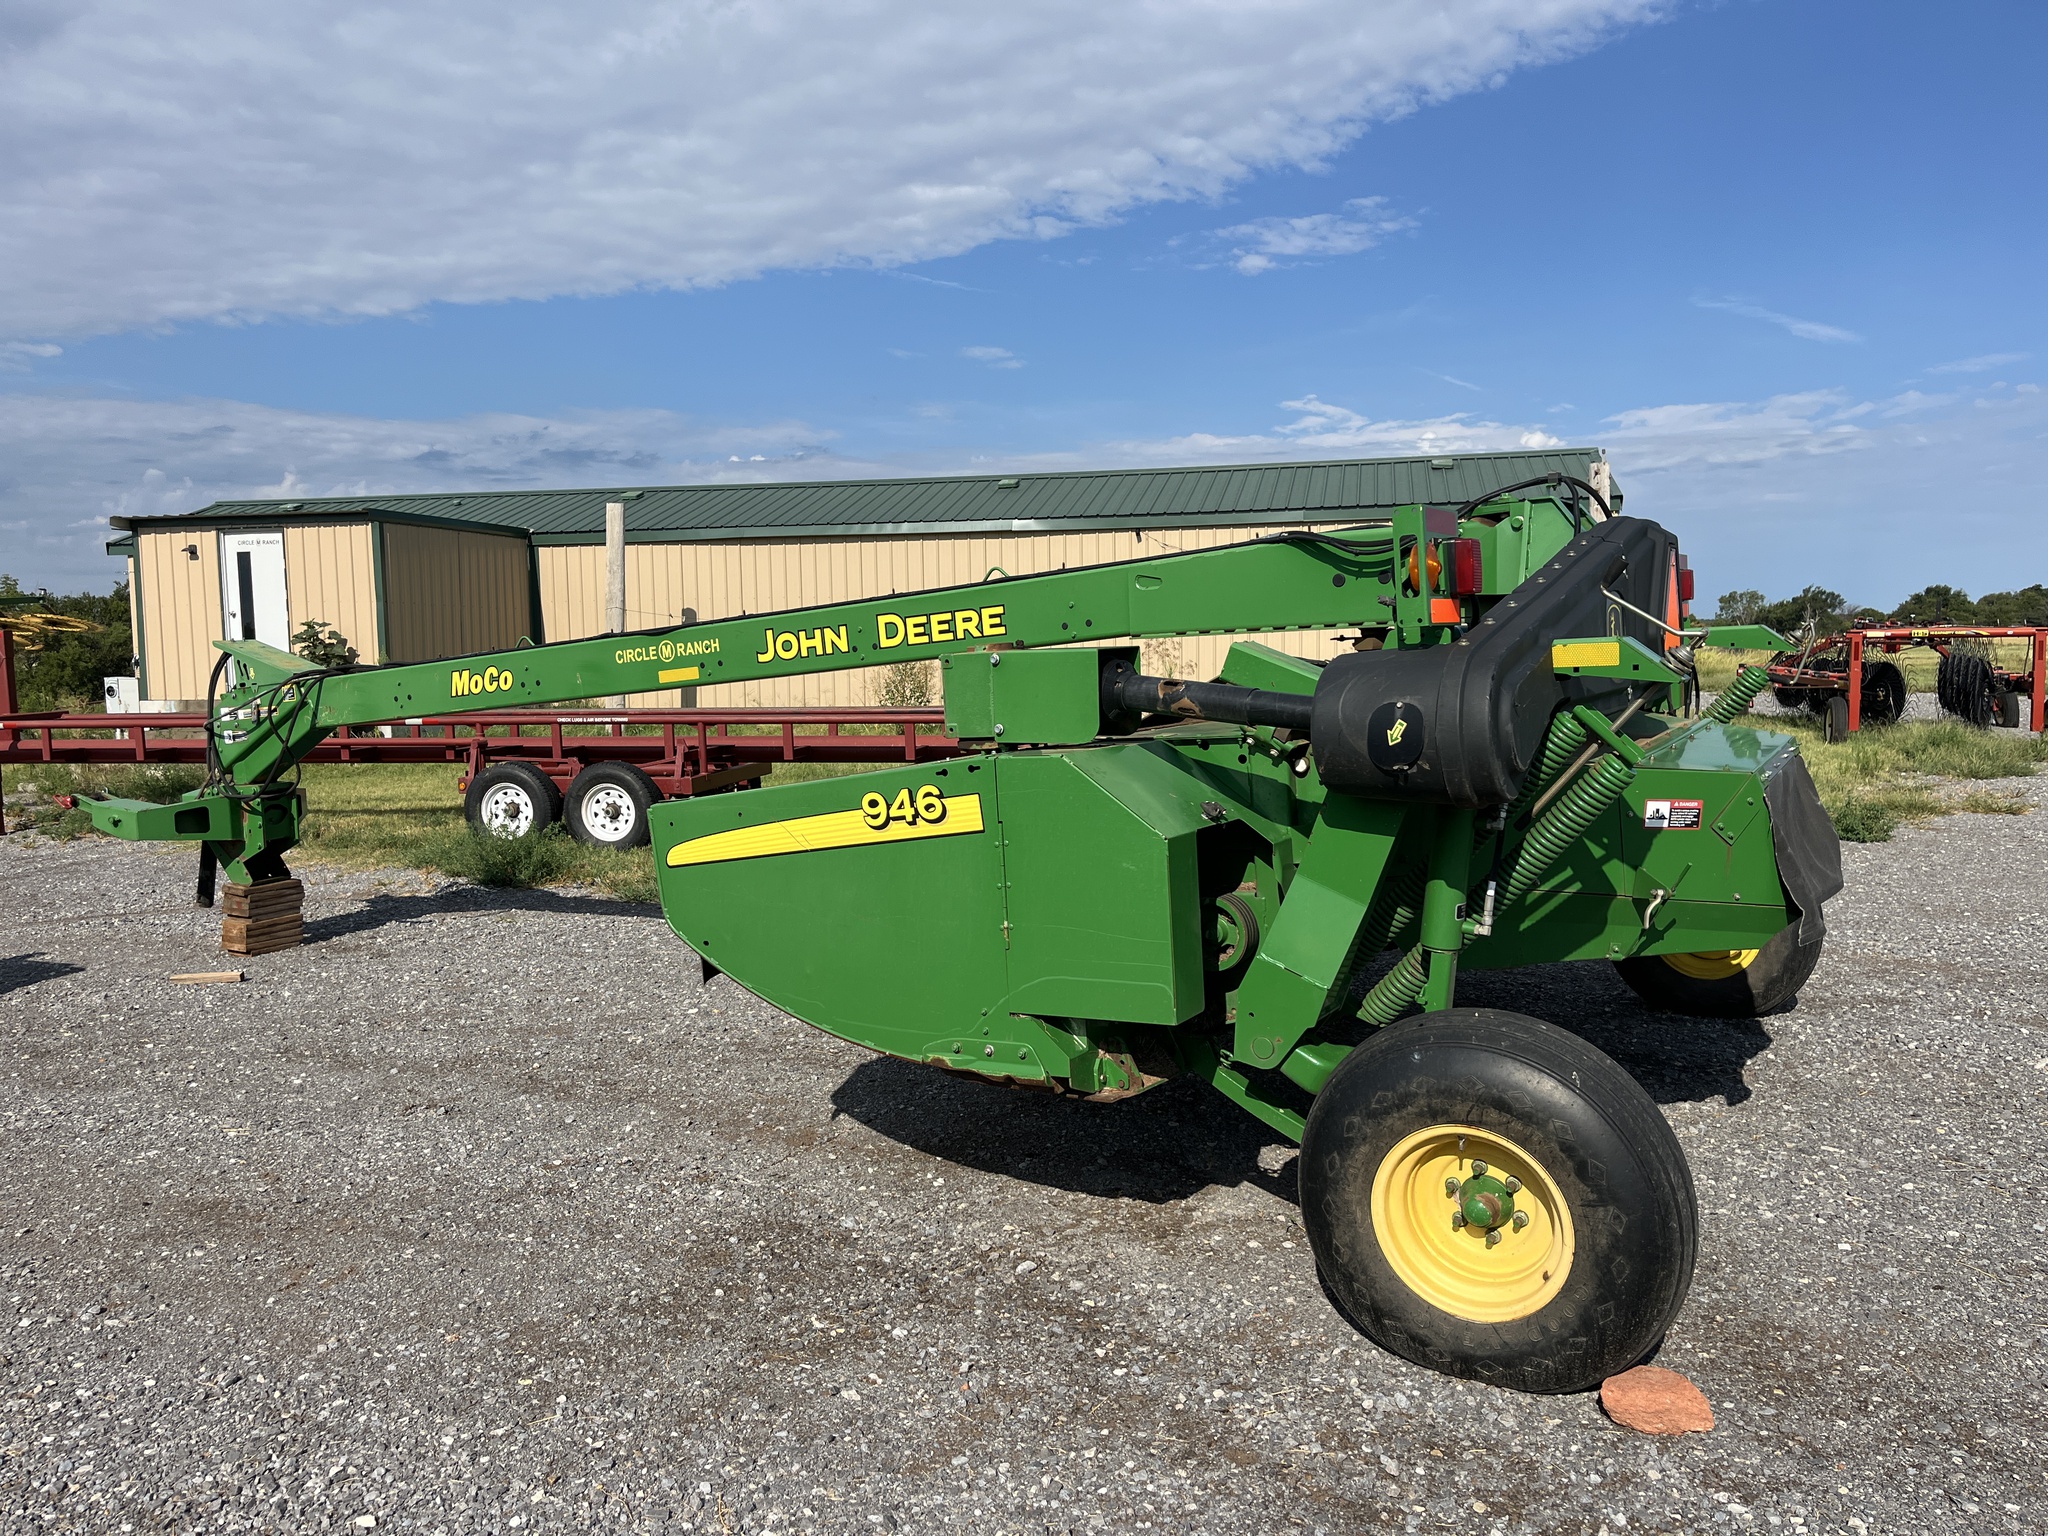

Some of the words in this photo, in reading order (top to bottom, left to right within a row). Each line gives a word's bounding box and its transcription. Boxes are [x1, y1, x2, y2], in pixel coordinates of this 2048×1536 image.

[615, 646, 658, 664] CIRCLE
[676, 638, 720, 657] RANCH
[756, 623, 849, 664] JOHN
[875, 604, 1007, 650] DEERE
[451, 665, 514, 698] MoCo
[861, 784, 947, 830] 946
